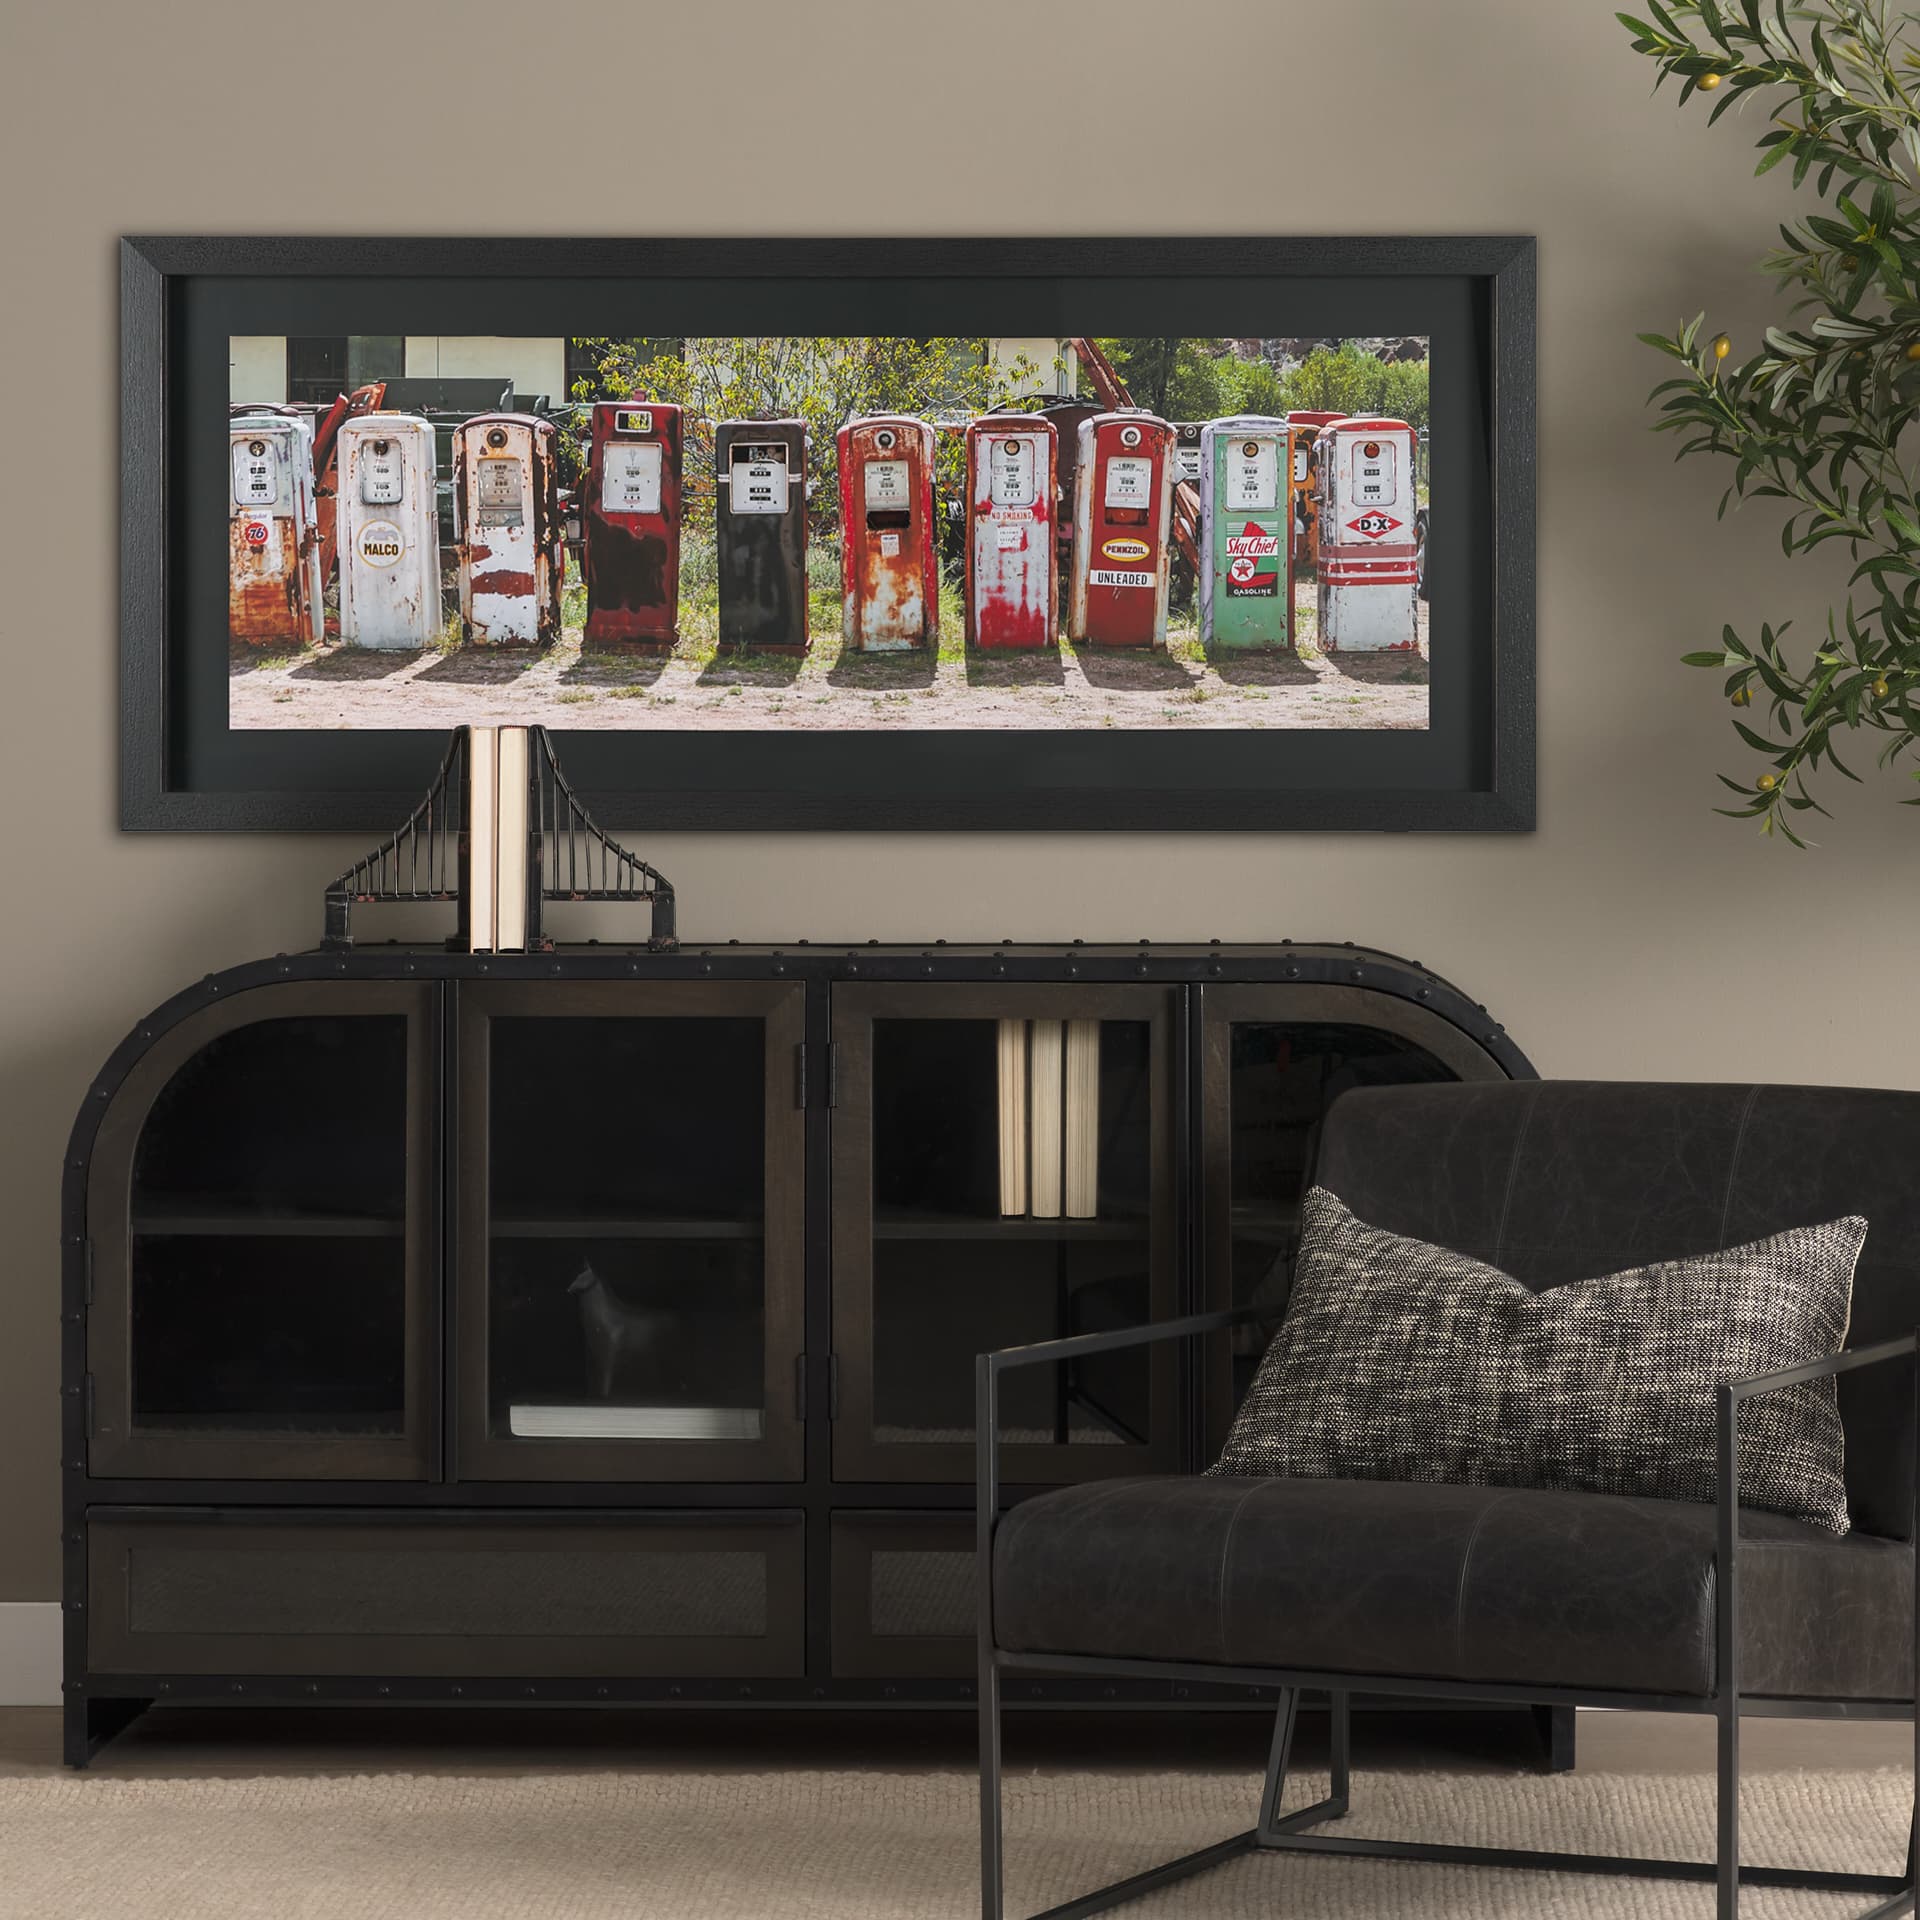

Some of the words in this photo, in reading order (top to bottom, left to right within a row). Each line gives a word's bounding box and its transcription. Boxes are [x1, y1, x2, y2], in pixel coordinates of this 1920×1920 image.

[991, 511, 1000, 520] NO
[1002, 511, 1032, 520] SMOKING
[249, 526, 265, 539] 76
[364, 543, 399, 556] MALCO
[1106, 545, 1145, 554] PENNZOIL
[1226, 537, 1248, 557] Sky
[1248, 537, 1279, 554] Chief
[1098, 572, 1148, 585] UNLEADED
[1233, 588, 1272, 596] GASOLINE
